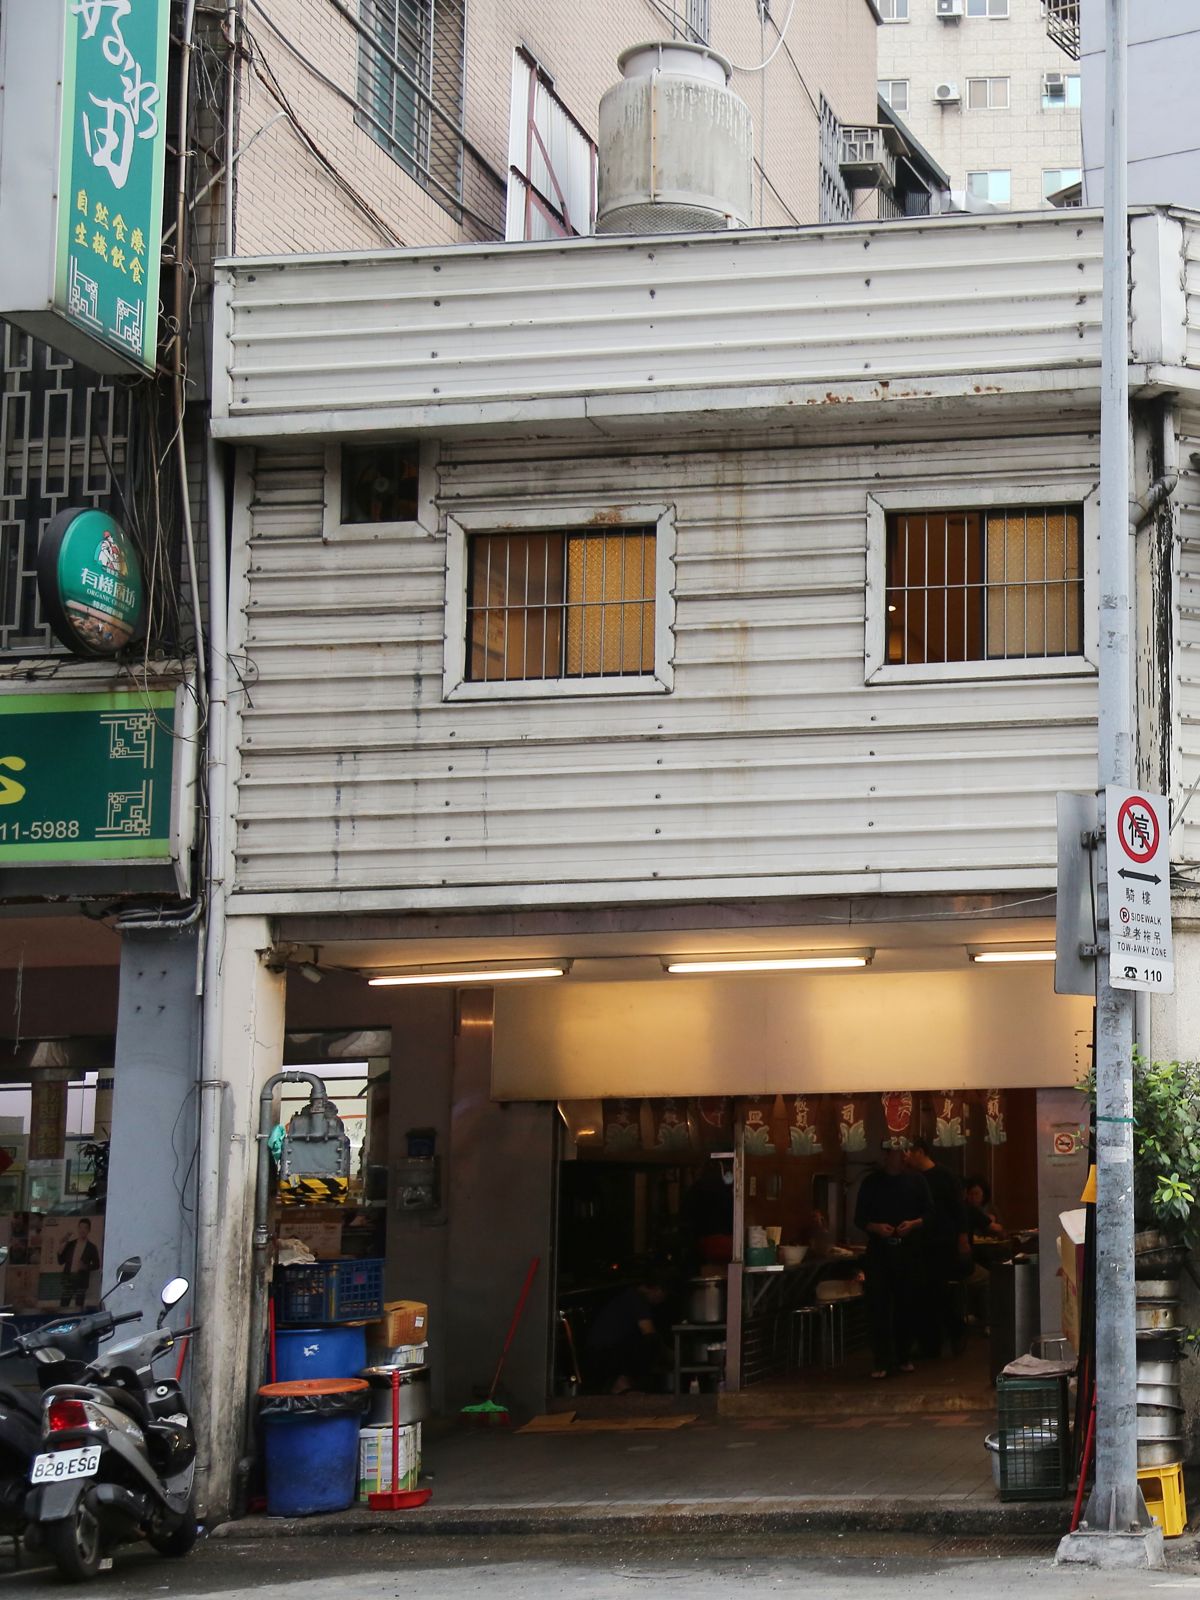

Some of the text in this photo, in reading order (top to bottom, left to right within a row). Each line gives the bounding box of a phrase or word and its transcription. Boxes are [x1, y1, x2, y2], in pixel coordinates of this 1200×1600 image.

[1128, 811, 1150, 849] 停
[1126, 888, 1151, 906] 騎樓
[1131, 912, 1162, 925] SIDEWALK
[1123, 926, 1161, 944] 違者拖吊
[1117, 942, 1167, 957] TOW-AWAY ZONE
[1144, 968, 1162, 982] 110
[34, 1456, 97, 1477] 828-ESG
